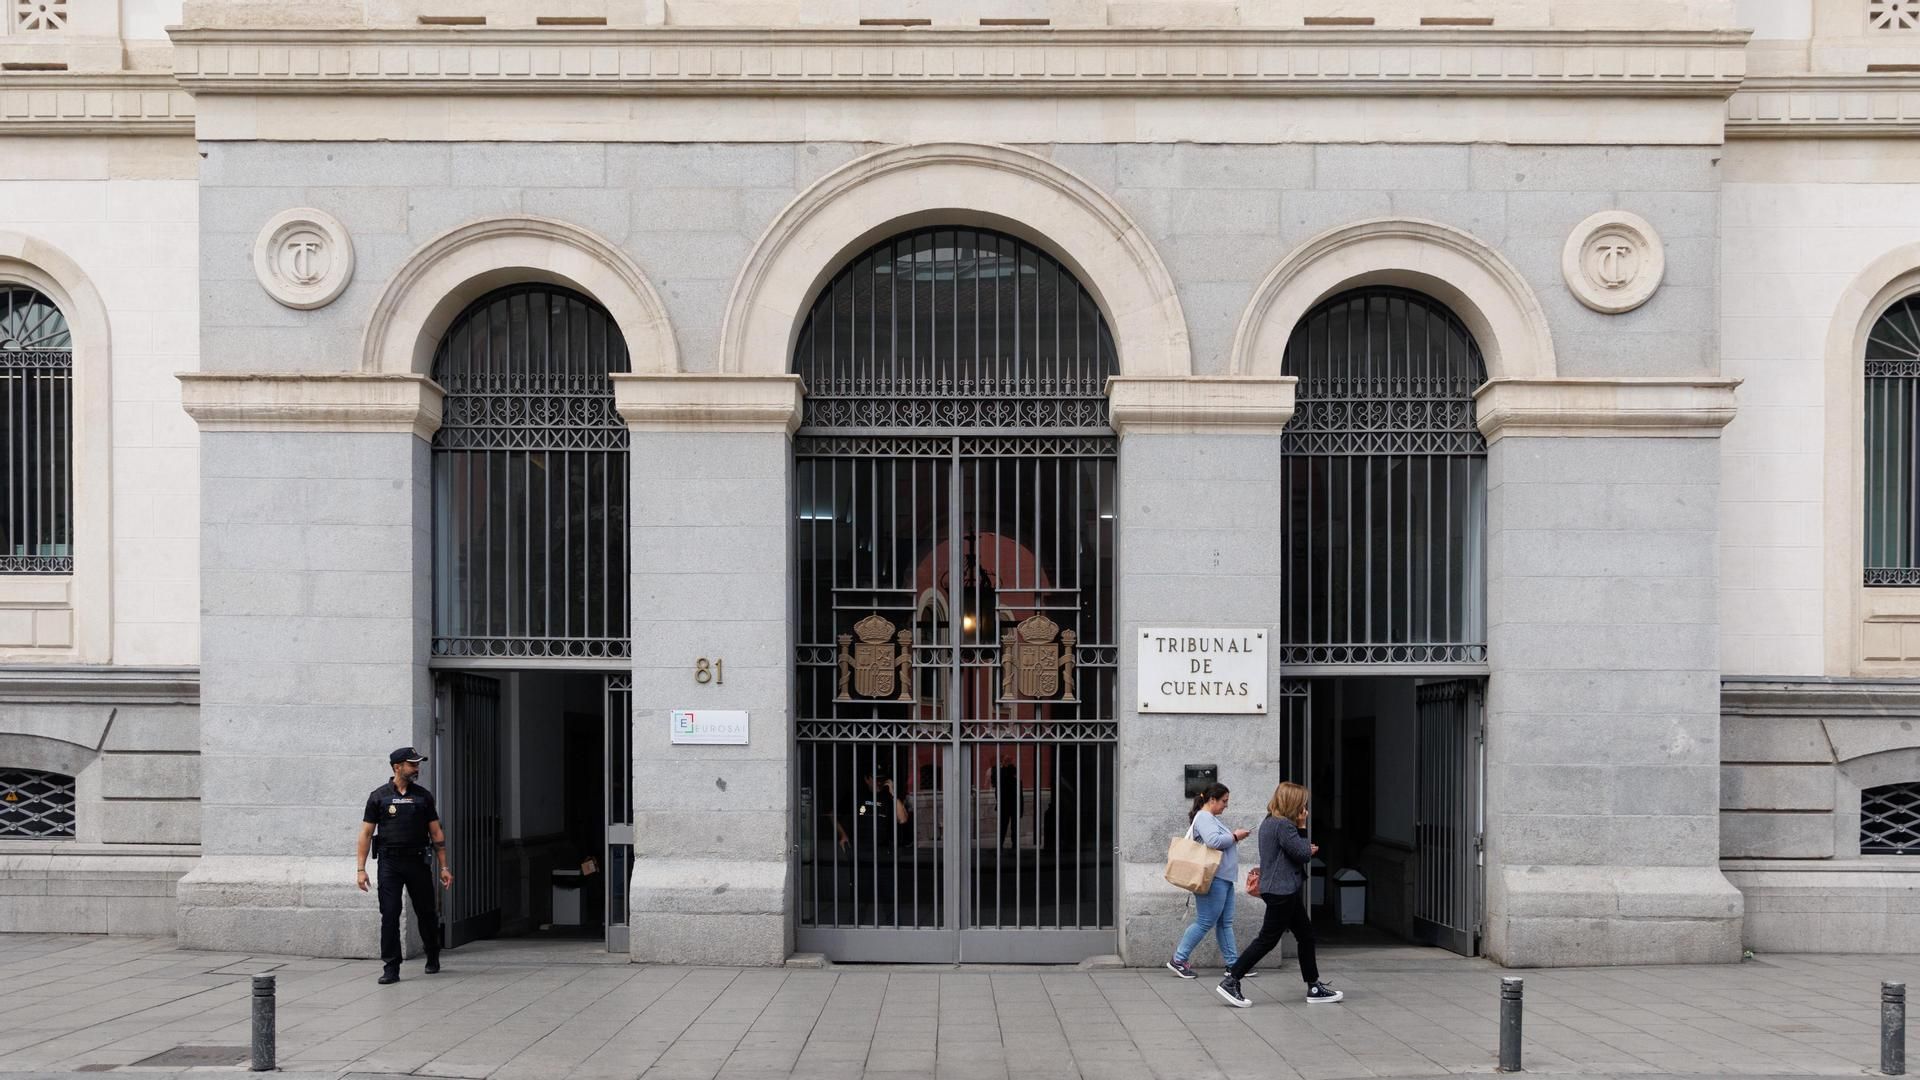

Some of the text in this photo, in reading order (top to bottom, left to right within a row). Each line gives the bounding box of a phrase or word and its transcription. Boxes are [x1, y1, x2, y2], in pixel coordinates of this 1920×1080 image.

[1155, 637, 1253, 653] TRIBUNAL
[695, 658, 723, 684] 81
[1190, 658, 1213, 674] DE
[1160, 681, 1248, 696] CUENTAS
[695, 724, 746, 733] EUROSAI
